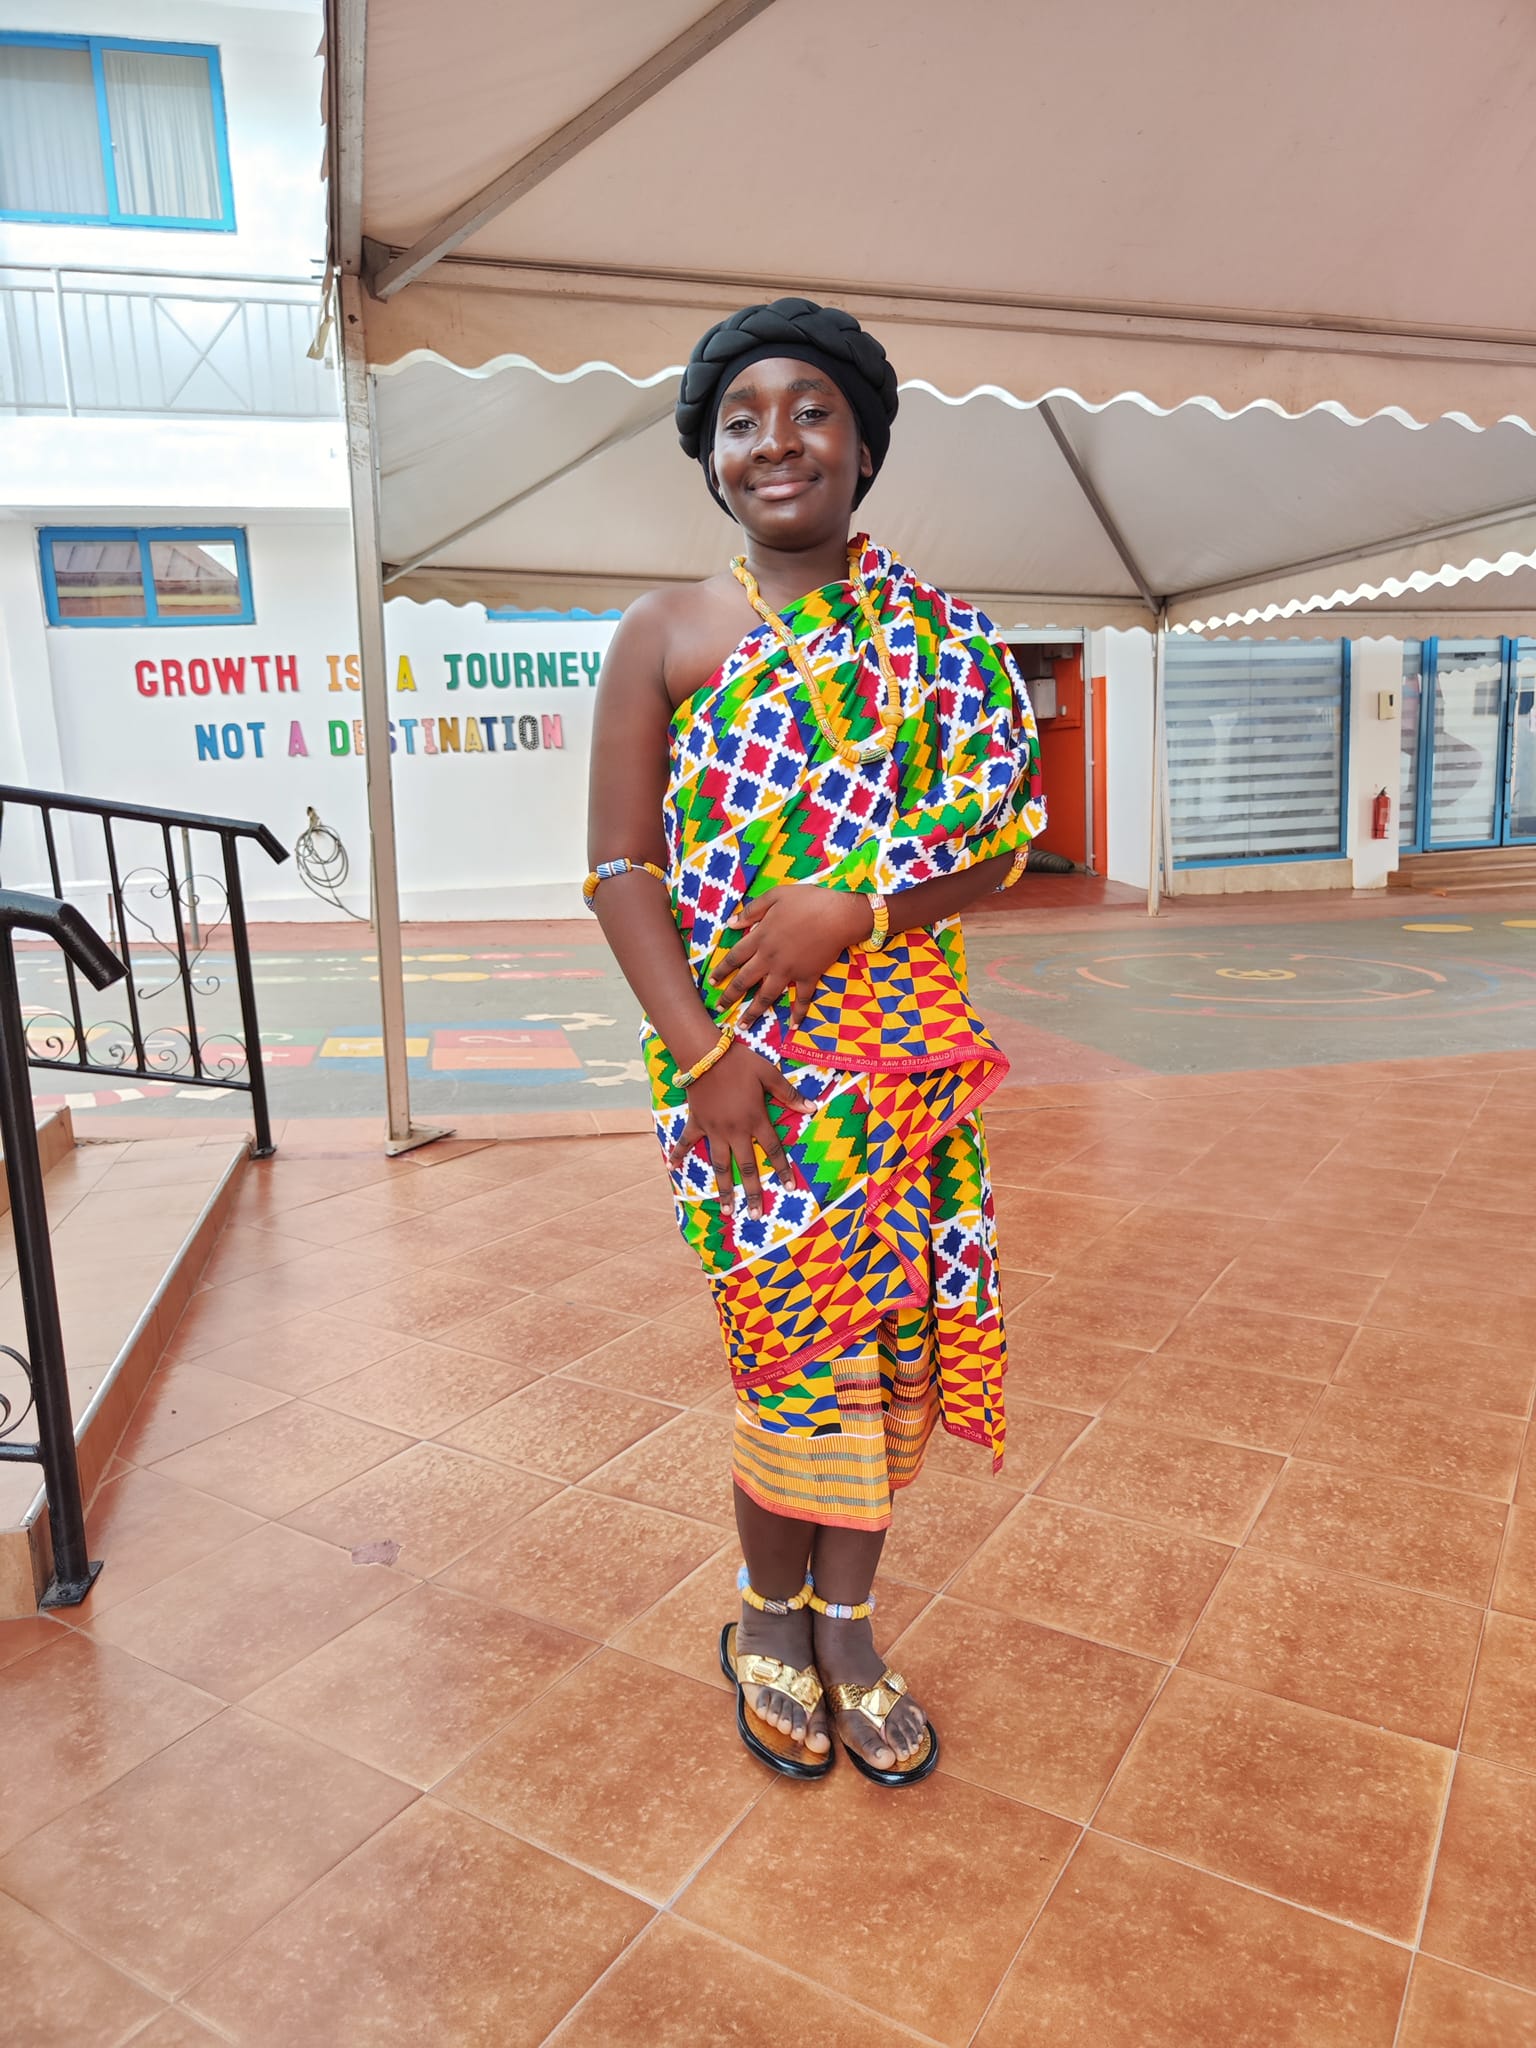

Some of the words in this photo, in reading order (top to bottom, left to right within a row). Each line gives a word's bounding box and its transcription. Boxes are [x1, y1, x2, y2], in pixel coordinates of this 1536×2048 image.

[135, 655, 299, 697] GROWTH
[326, 655, 361, 691] IS
[397, 655, 416, 691] A
[443, 651, 601, 690] JOURNEY
[195, 722, 265, 760] NOT
[288, 721, 308, 757] A
